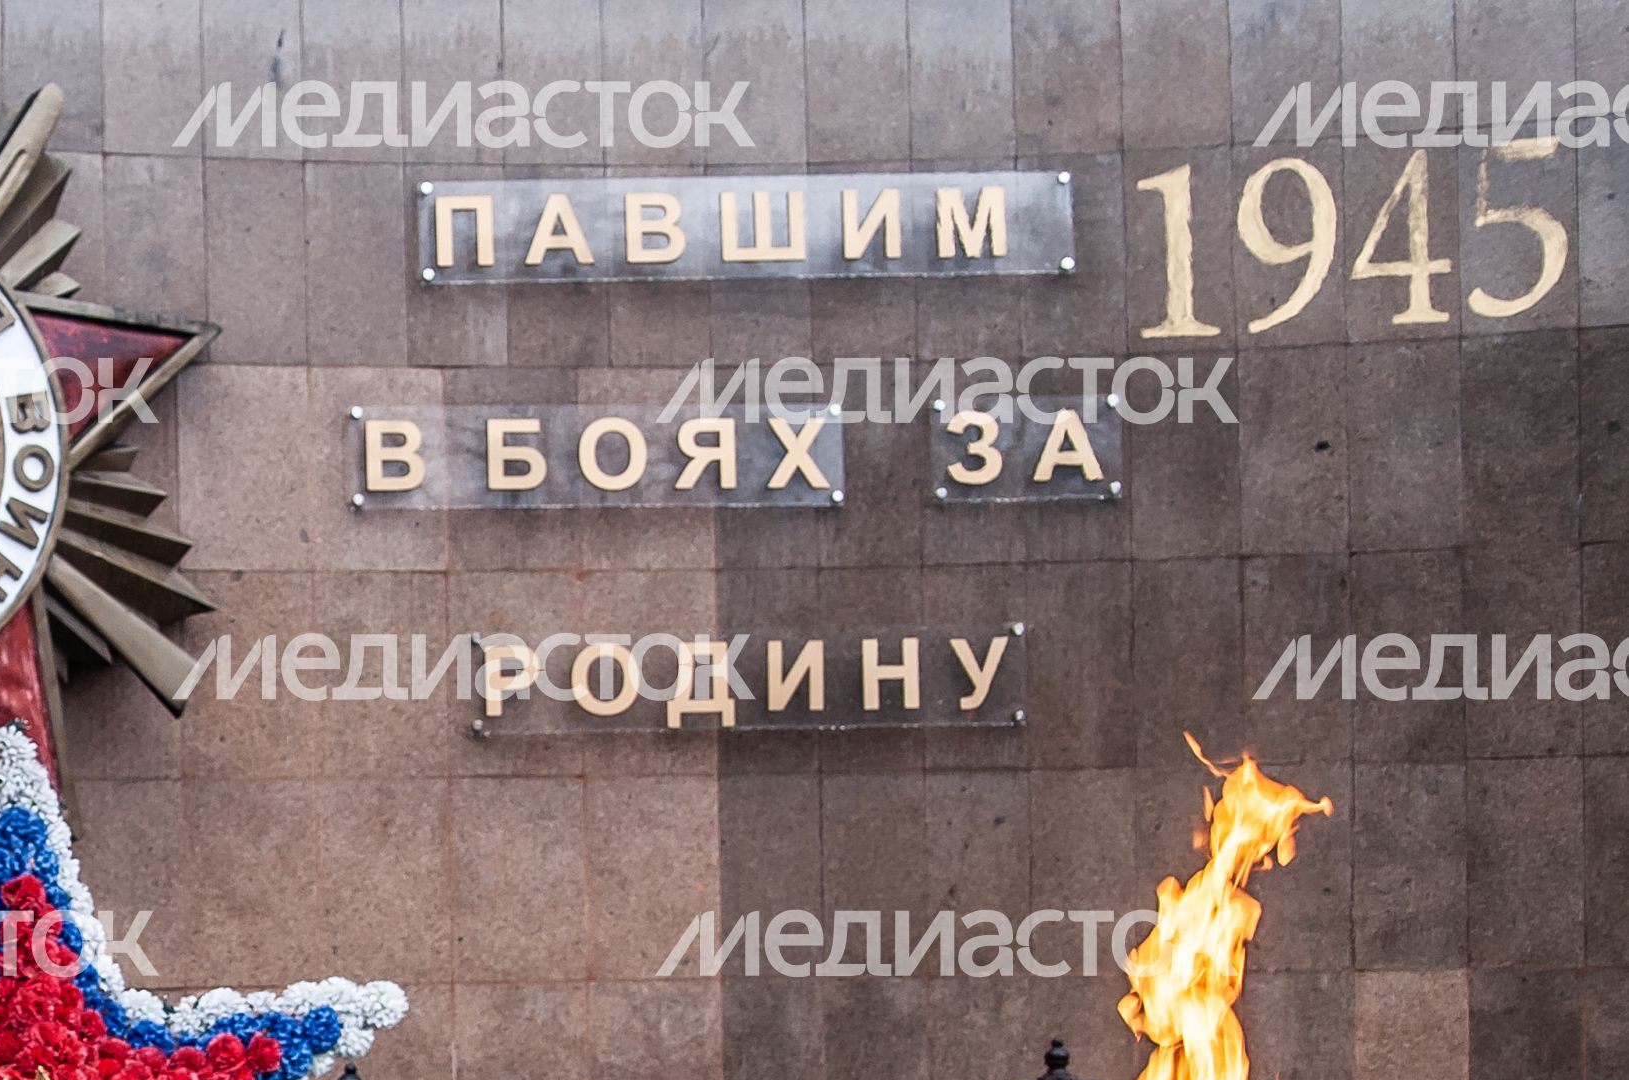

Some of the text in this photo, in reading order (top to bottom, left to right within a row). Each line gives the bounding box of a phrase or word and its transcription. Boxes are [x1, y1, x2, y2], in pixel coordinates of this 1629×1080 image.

[435, 187, 1010, 268] ПАВШИМ
[1137, 134, 1569, 340] 1945
[364, 408, 1104, 492] В БОЯХ ЗА
[483, 636, 1009, 728] РОДИНУ
